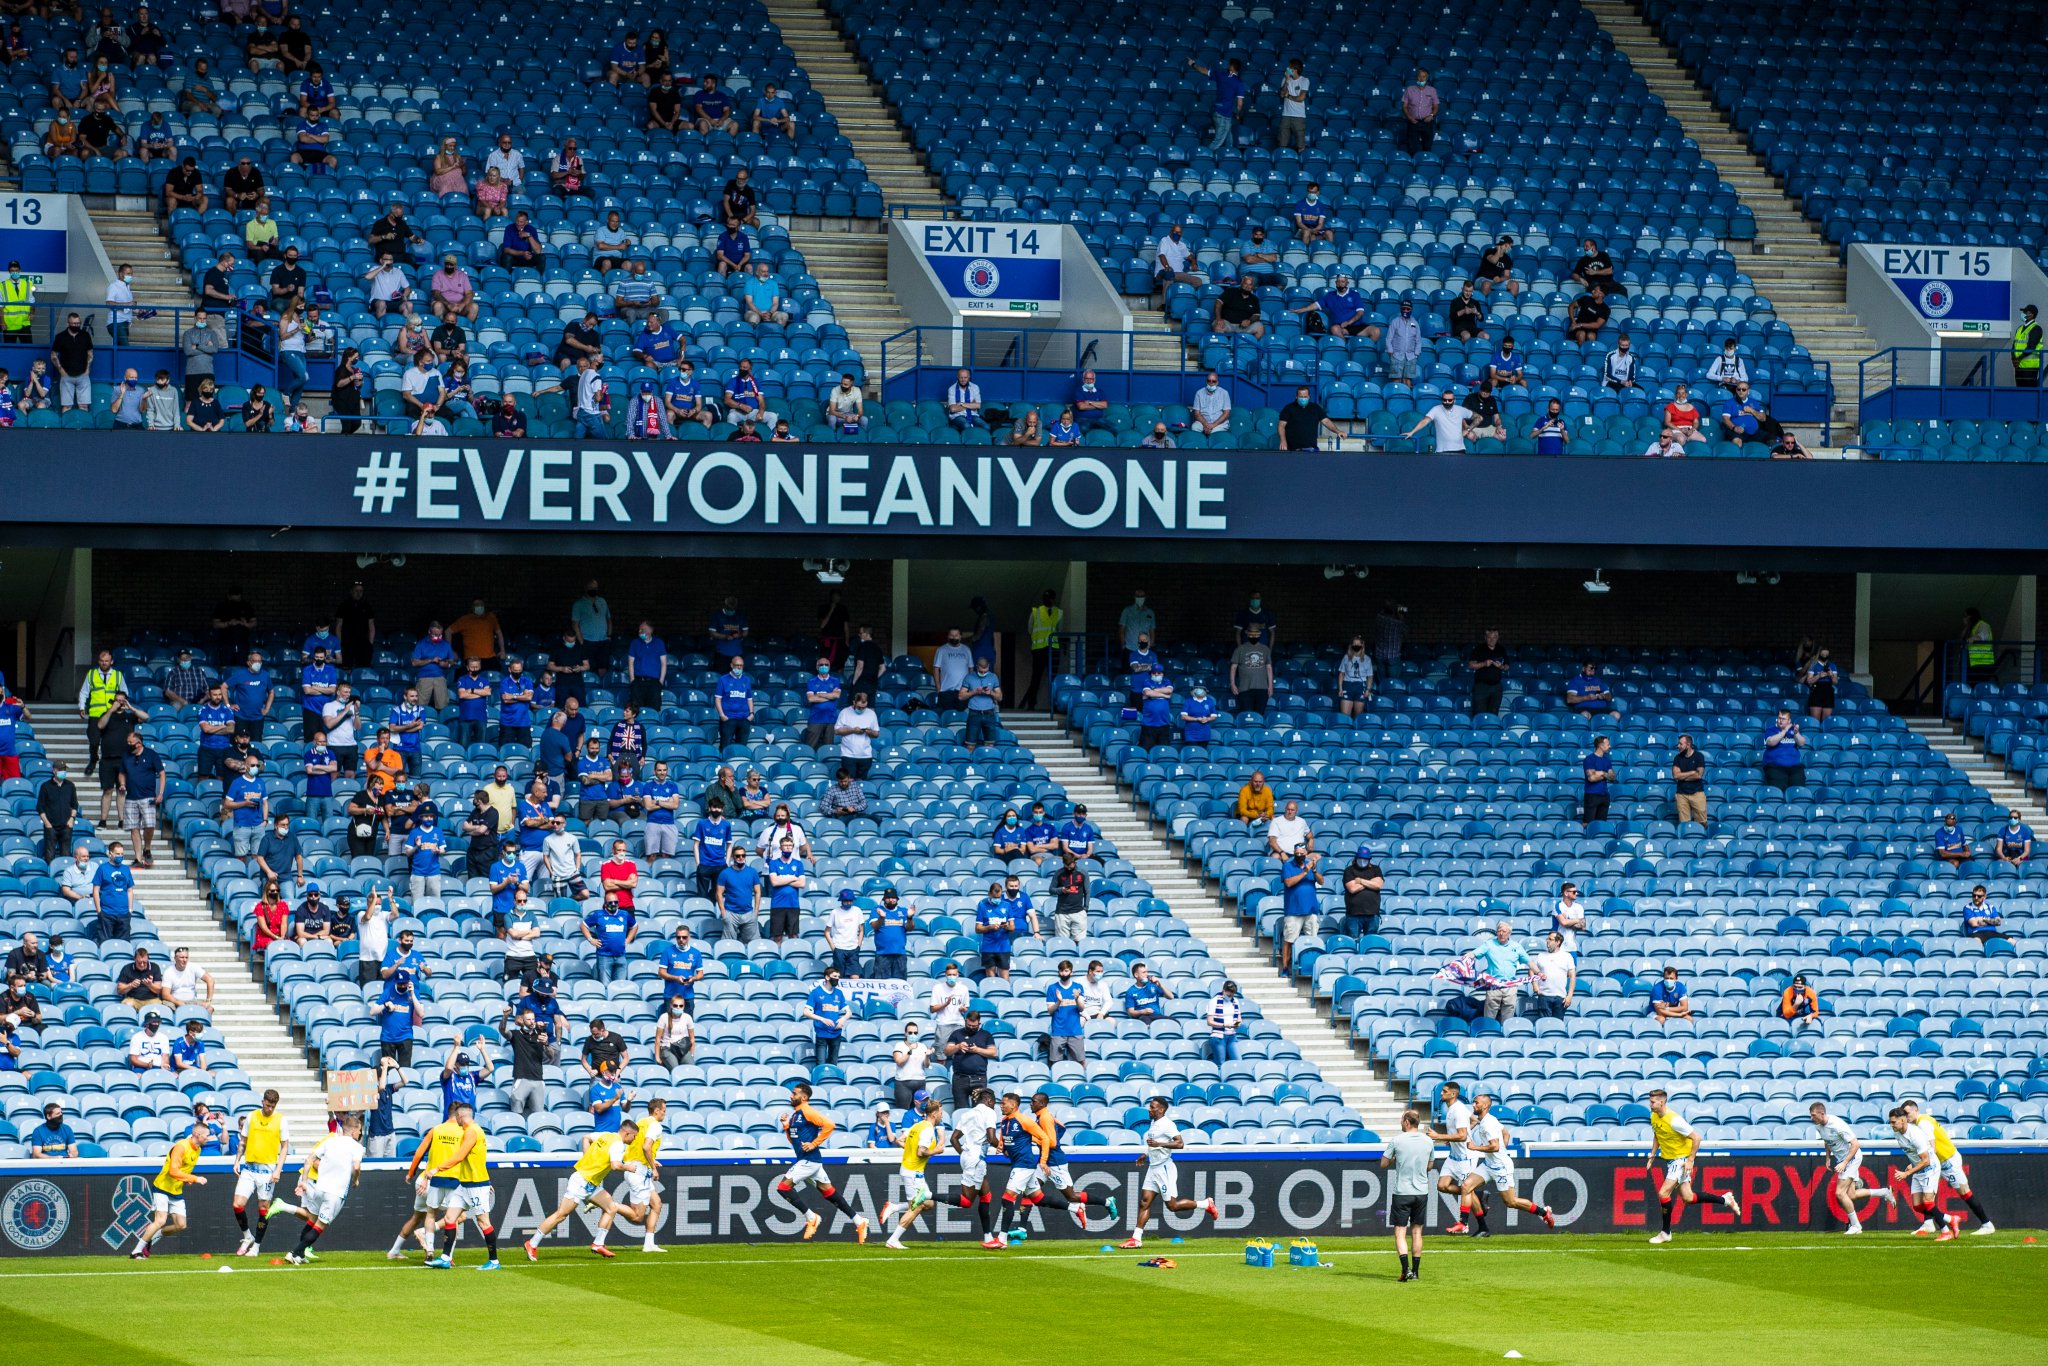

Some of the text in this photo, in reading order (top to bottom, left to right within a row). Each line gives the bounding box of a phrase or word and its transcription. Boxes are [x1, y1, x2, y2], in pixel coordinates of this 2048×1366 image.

[6, 198, 42, 226] 13
[924, 225, 1040, 255] EXIT 14
[1884, 249, 1990, 276] EXIT 15
[353, 447, 1227, 530] #EVERYONEANYONE
[9, 1182, 62, 1203] RANGERS
[265, 1182, 272, 1192] 15
[1161, 1184, 1168, 1194] 9
[1497, 1175, 1507, 1184] 25
[456, 1174, 807, 1240] ANGERS
[1070, 1170, 1255, 1232] CLUB
[1278, 1168, 1466, 1230] OPN
[470, 1196, 481, 1208] 32
[6, 1219, 64, 1246] FOOTBALL CLUB
